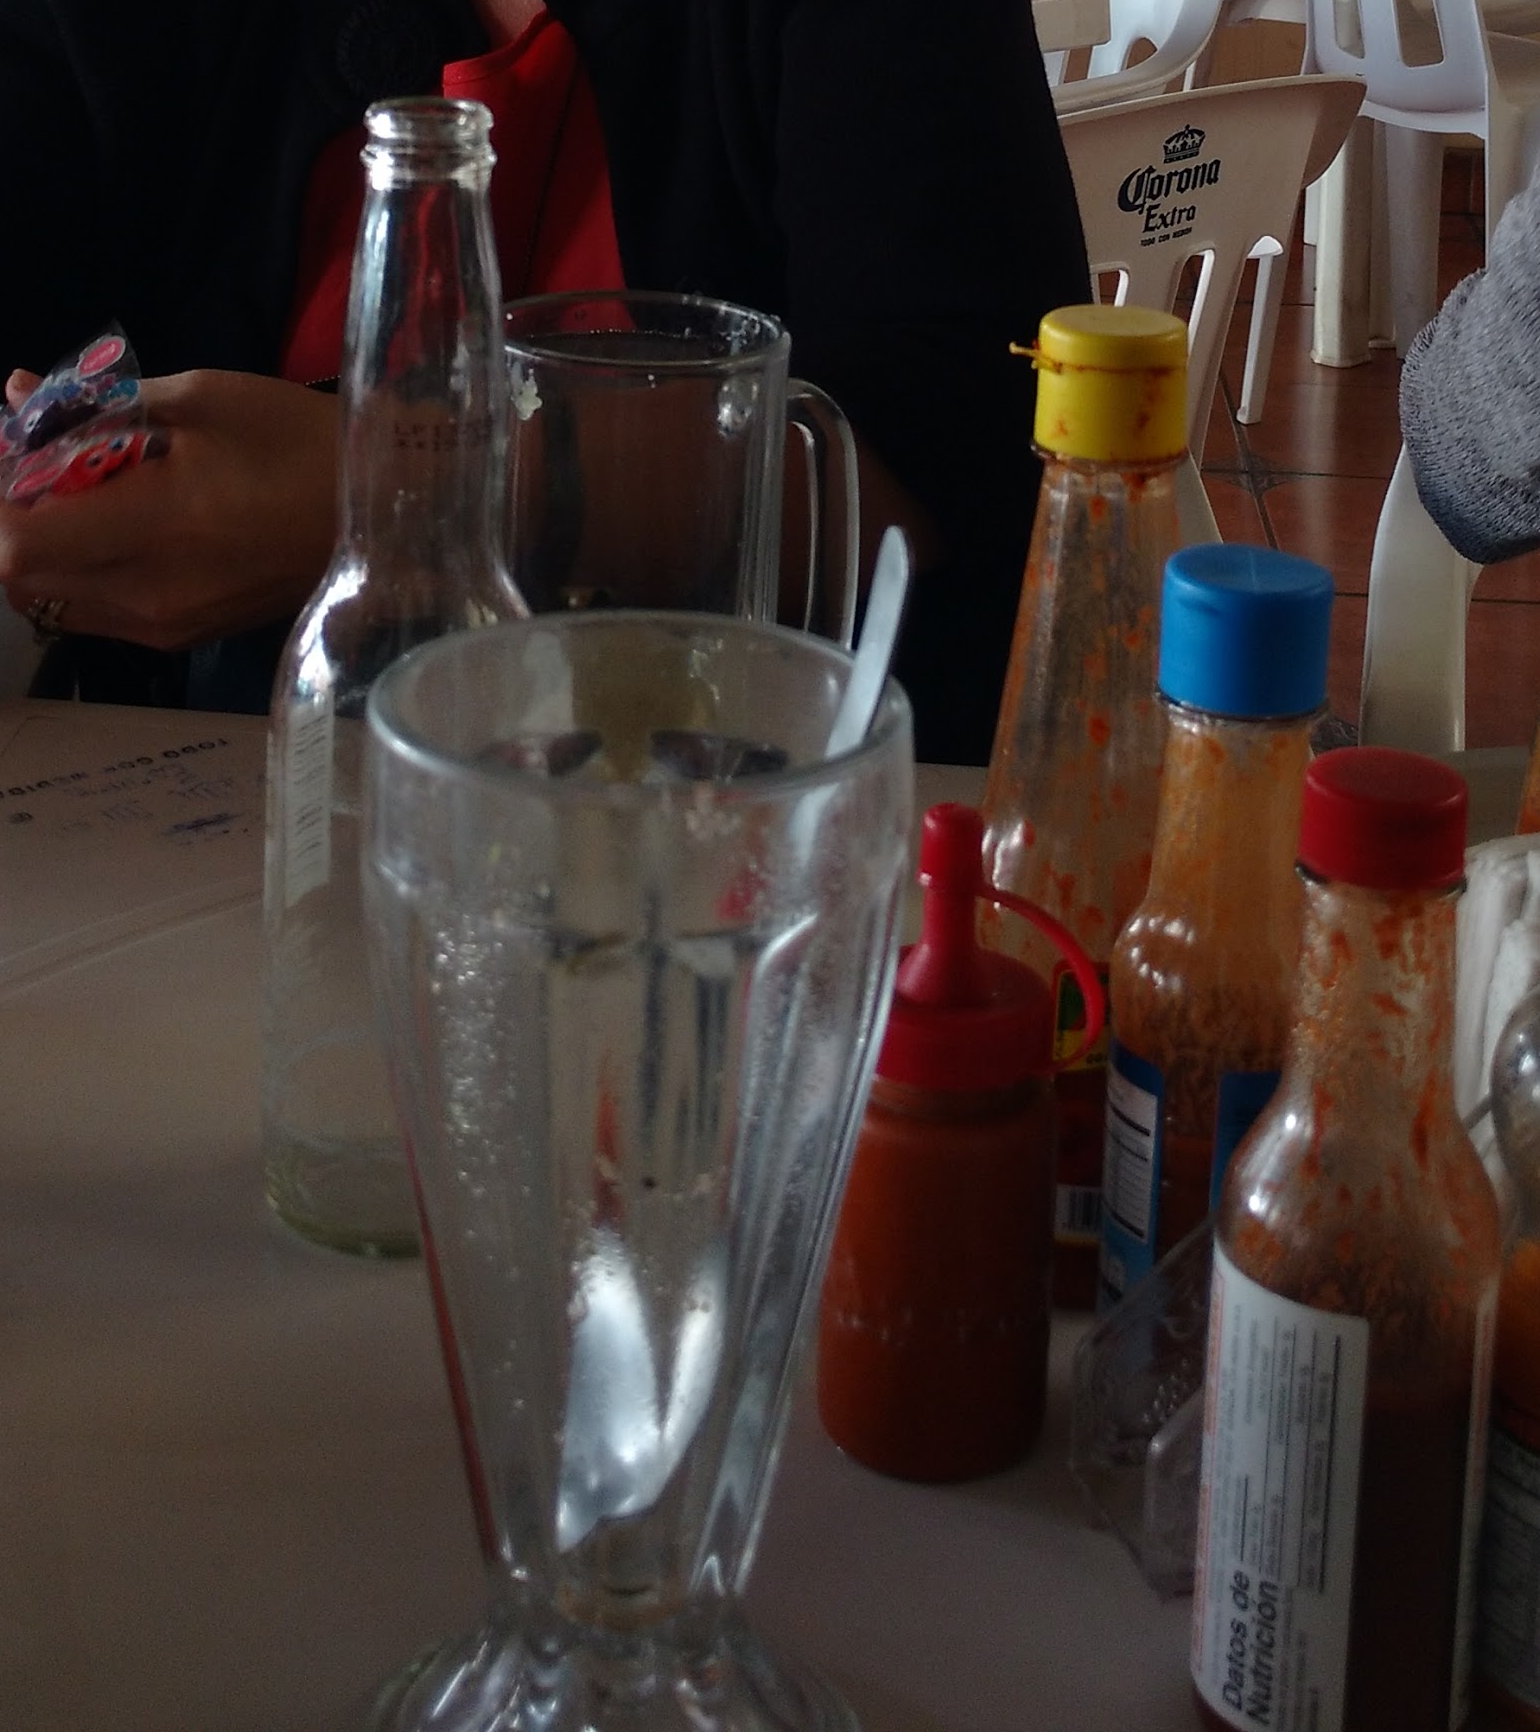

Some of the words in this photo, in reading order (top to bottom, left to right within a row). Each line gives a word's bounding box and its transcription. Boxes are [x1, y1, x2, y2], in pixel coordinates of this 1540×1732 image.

[1117, 159, 1221, 215] Corona
[1142, 203, 1197, 234] Extra
[1229, 1570, 1250, 1612] de
[1222, 1617, 1248, 1710] Datos
[1245, 1579, 1279, 1727] Nutrición
